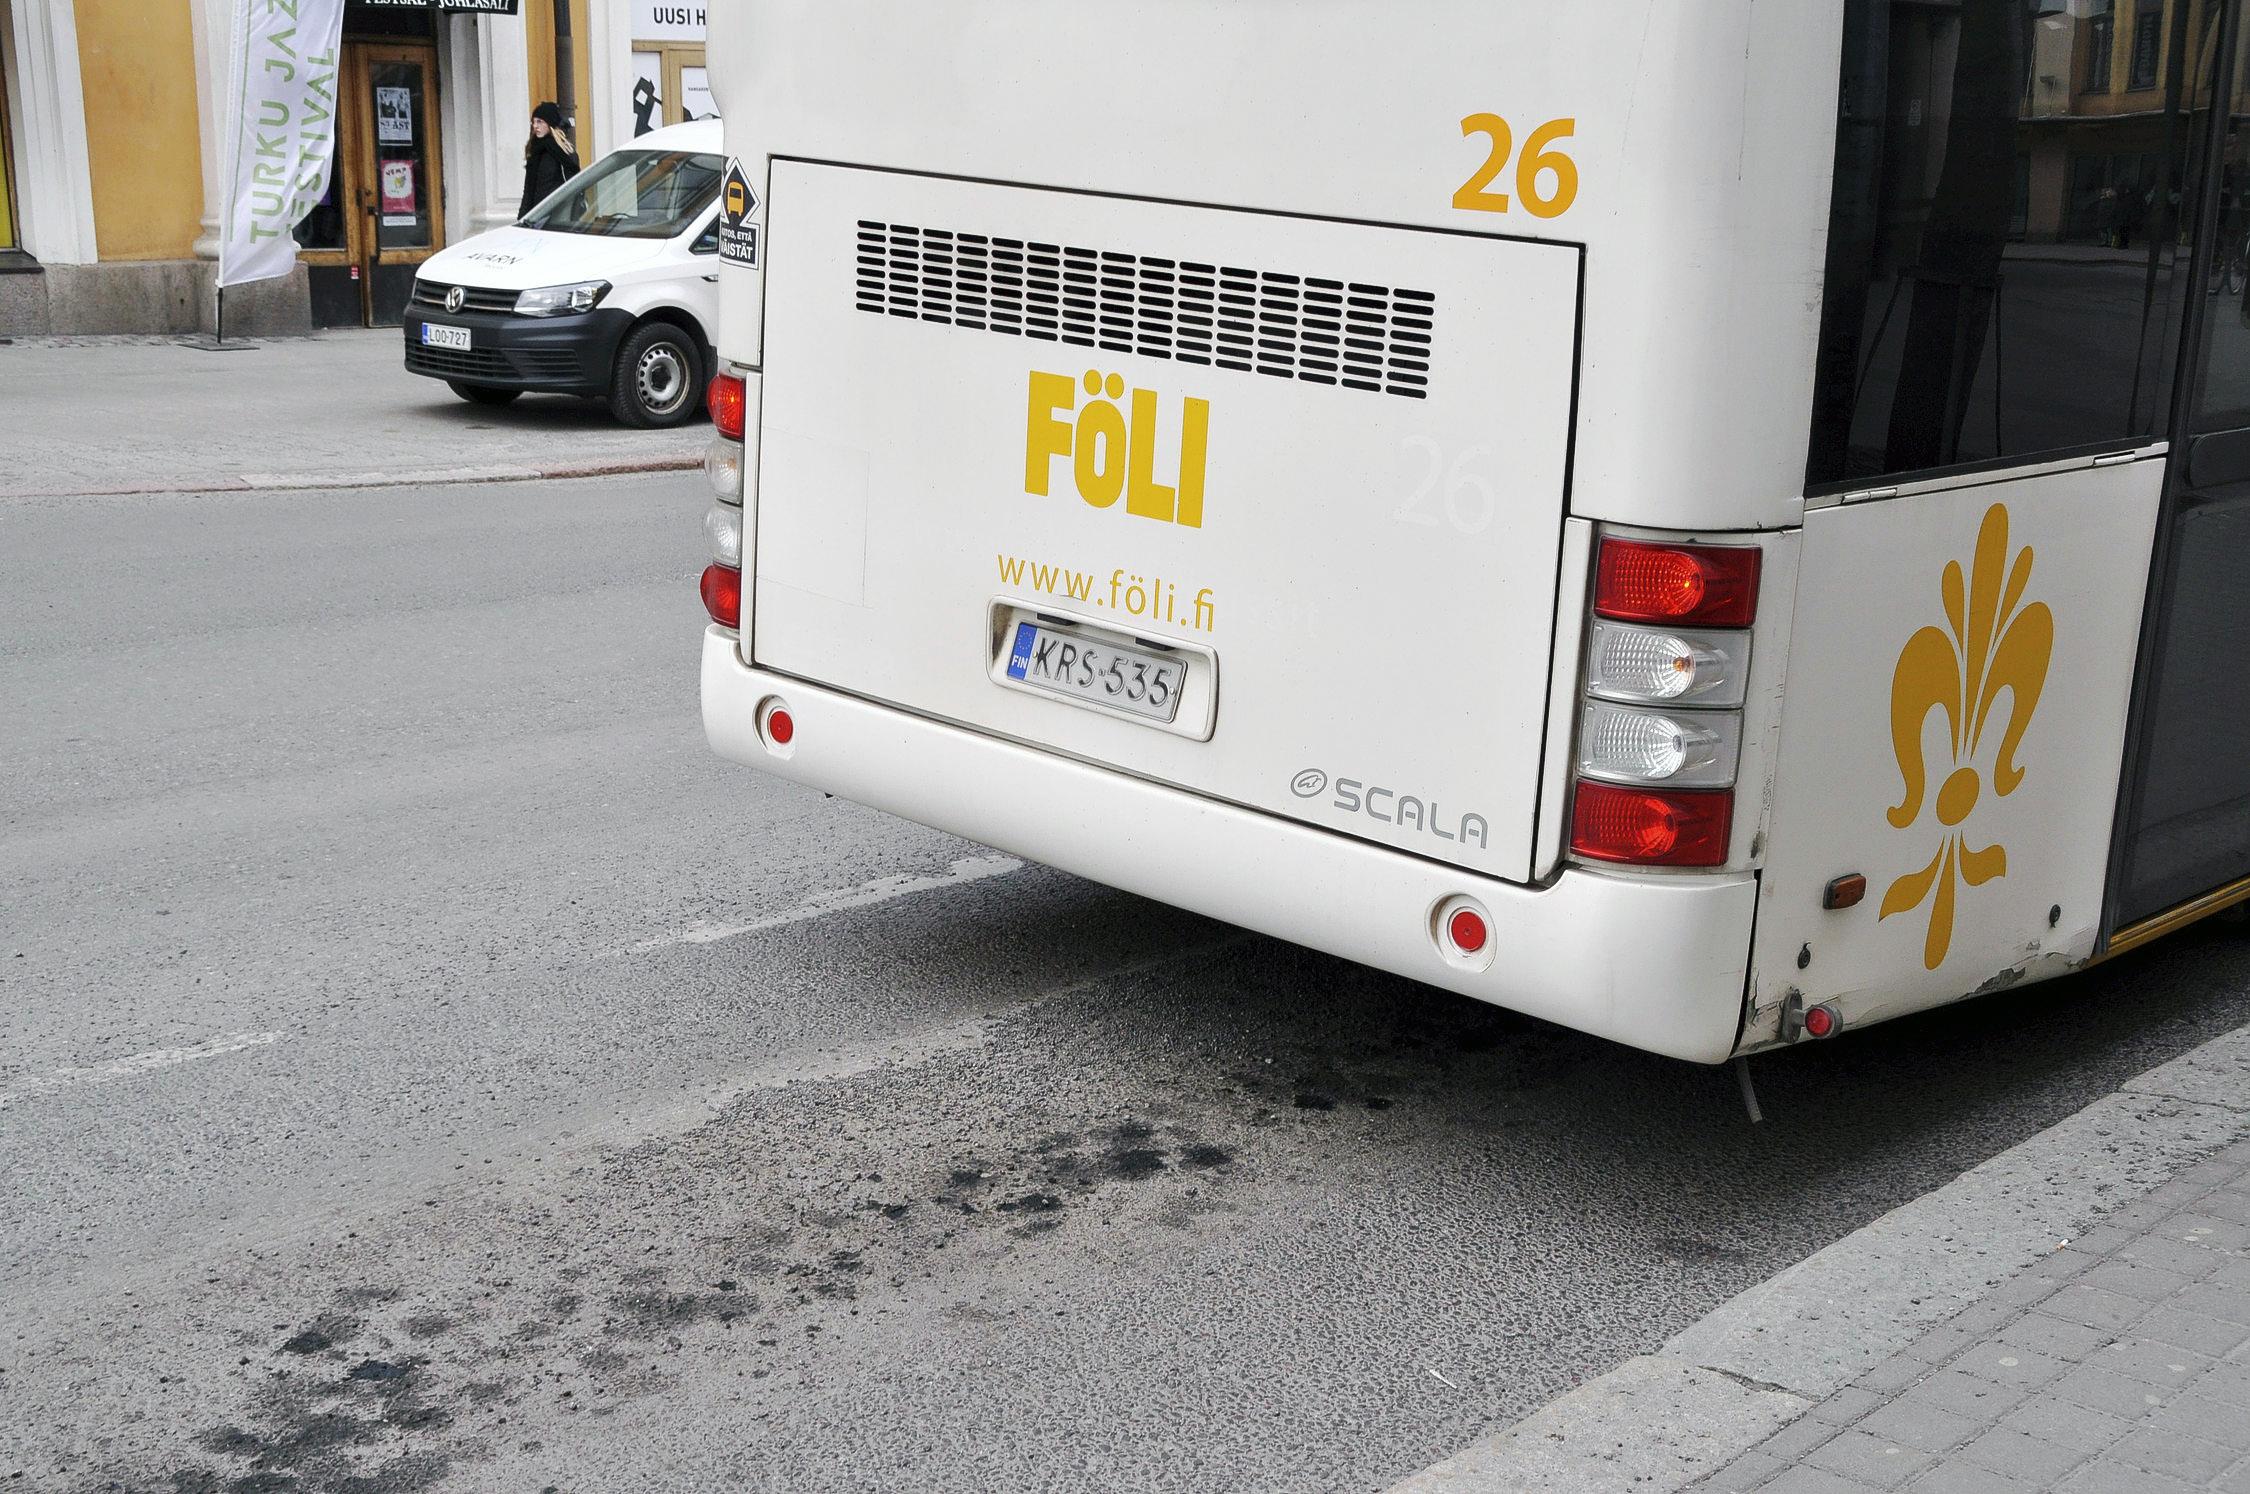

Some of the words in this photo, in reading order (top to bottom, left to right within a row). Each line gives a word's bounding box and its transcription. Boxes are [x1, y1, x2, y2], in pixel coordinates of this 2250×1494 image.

[653, 7, 691, 25] UUSI
[250, 100, 290, 244] TURKU
[285, 48, 334, 234] ESTIVAL
[1452, 113, 1579, 219] 26
[1024, 369, 1210, 528] FÖLI
[998, 555, 1215, 632] www.föli.fi
[1012, 655, 1028, 670] FIN
[1033, 638, 1172, 707] KRS-535
[1333, 777, 1489, 849] SCALA
